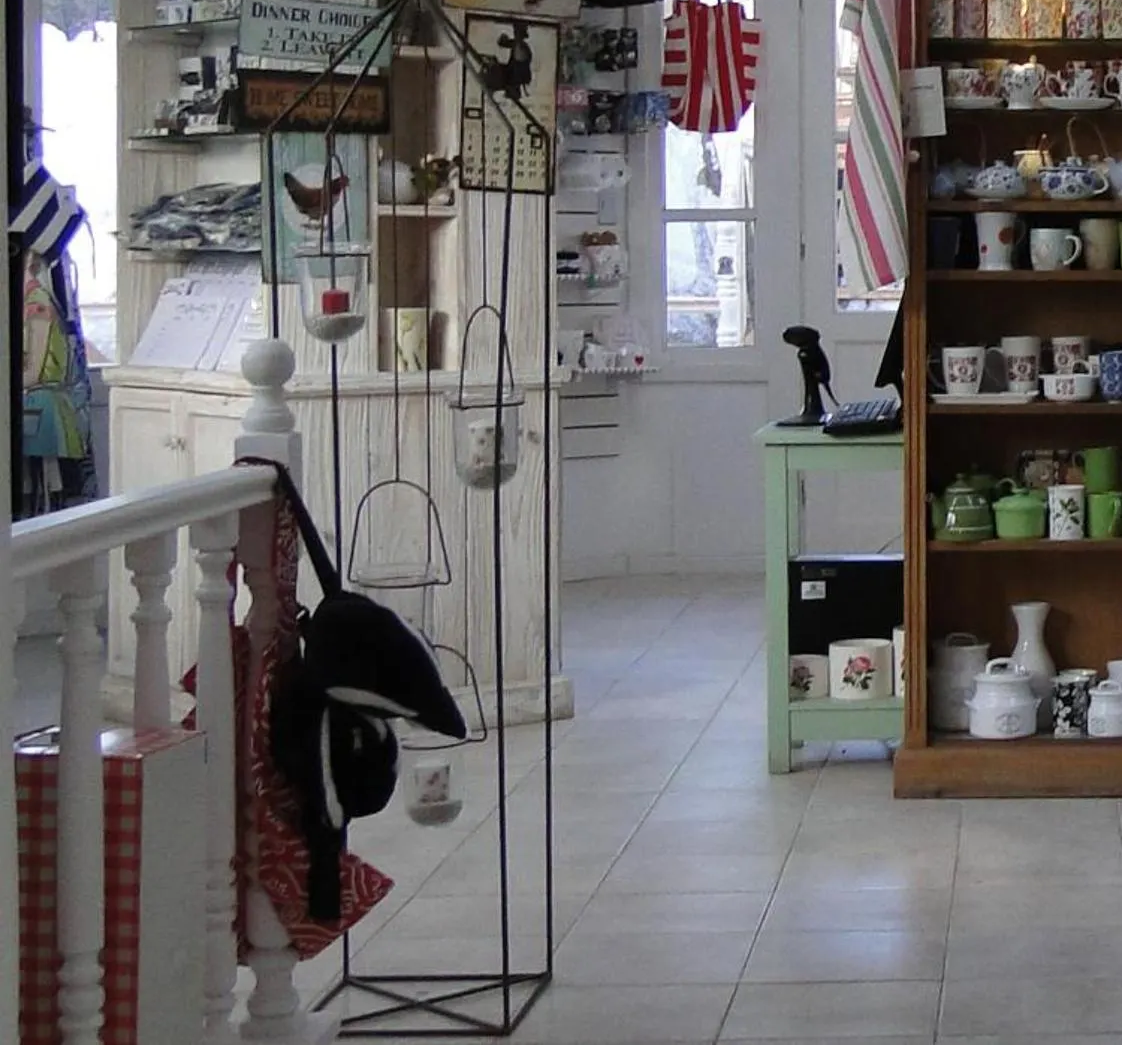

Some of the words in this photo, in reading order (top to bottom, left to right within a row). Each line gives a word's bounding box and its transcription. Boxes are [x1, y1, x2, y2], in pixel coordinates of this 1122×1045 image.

[252, 2, 311, 23] DINNER
[318, 8, 386, 31] CHOICE
[267, 26, 279, 39] 1.
[285, 26, 330, 44] TAKE
[280, 39, 337, 56] LEAV
